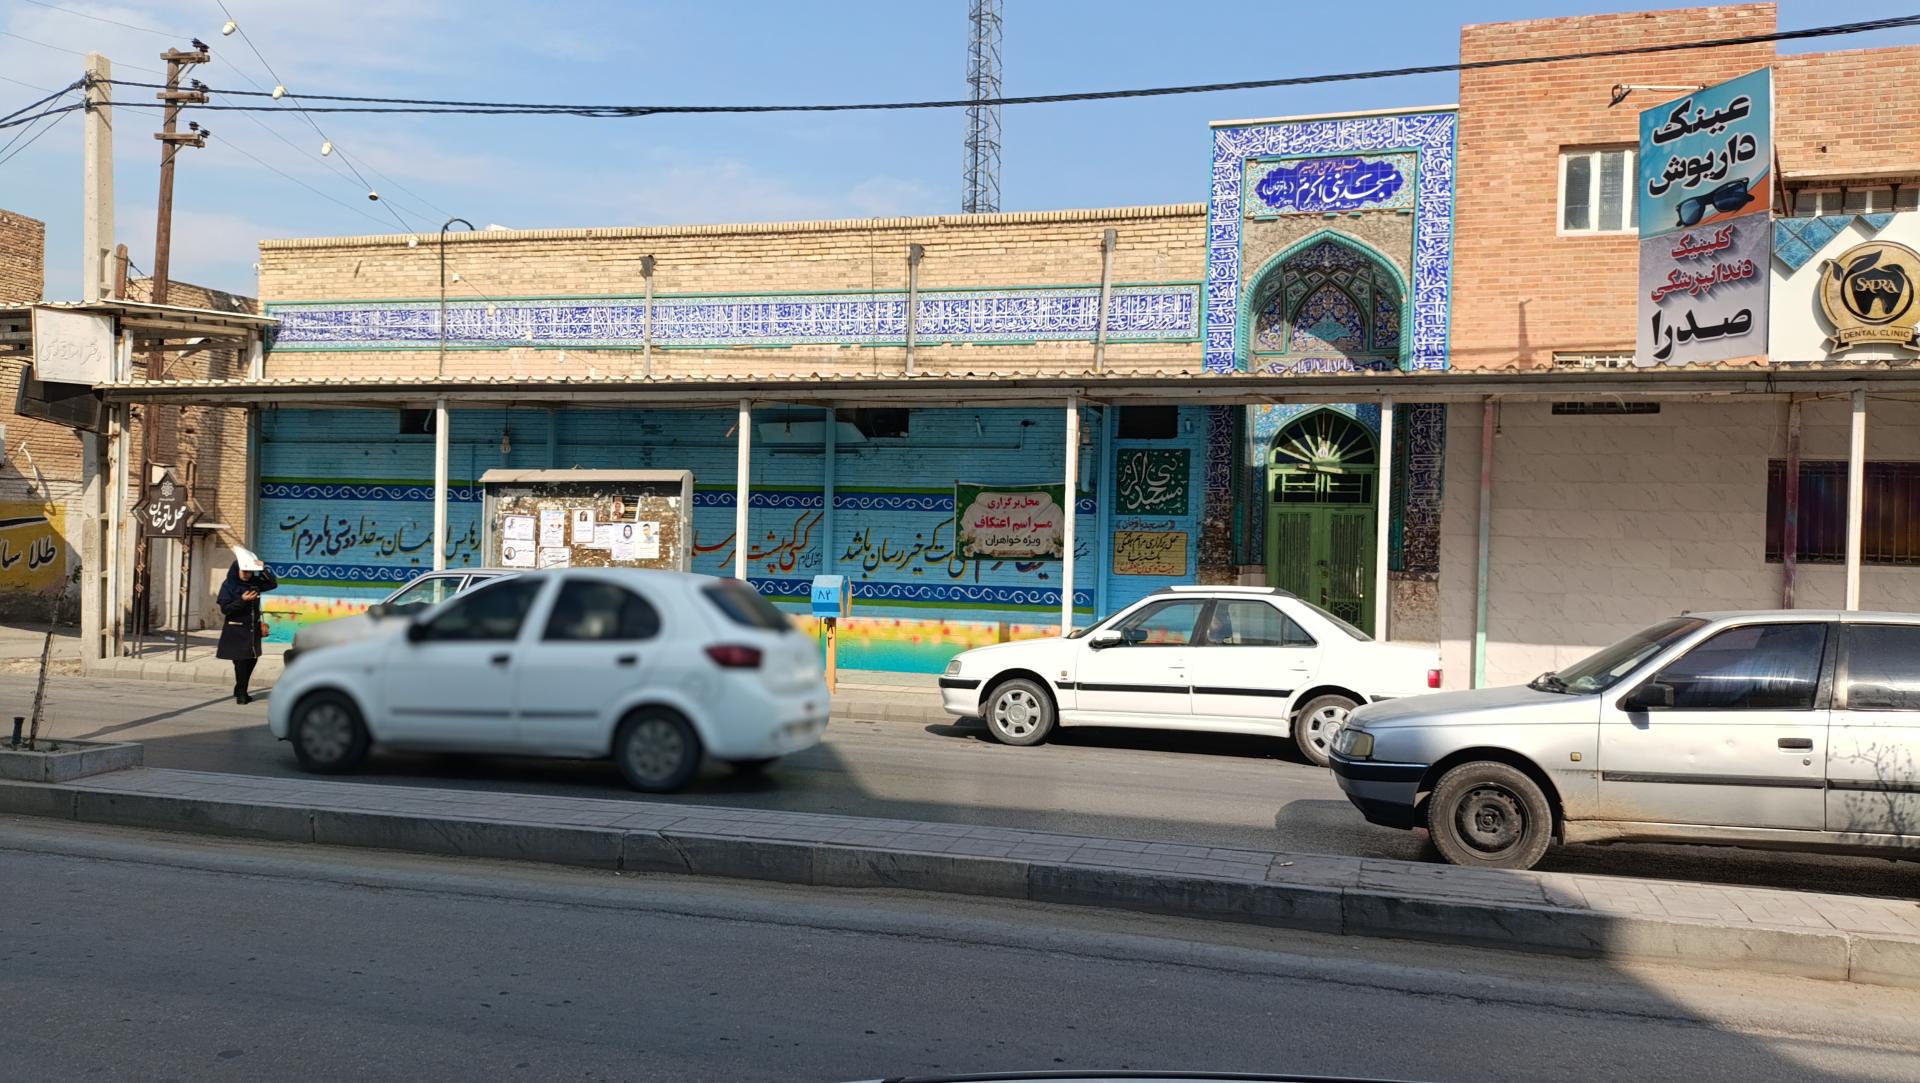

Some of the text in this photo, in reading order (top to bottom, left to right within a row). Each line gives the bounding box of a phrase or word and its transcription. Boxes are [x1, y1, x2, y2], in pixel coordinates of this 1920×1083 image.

[1653, 97, 1750, 143] عینک
[1650, 134, 1756, 194] داریوش
[1339, 173, 1396, 199] مسجد
[1671, 224, 1734, 259] کلینیک
[1651, 258, 1754, 302] دندانپزشکی
[1856, 278, 1900, 293] SADRA
[1652, 307, 1753, 359] صدرا
[1844, 329, 1910, 339] DENTAL CLINIC
[987, 496, 1040, 510] محل برگزاری
[1126, 485, 1183, 510] مسجد
[279, 513, 310, 549] است
[358, 515, 377, 545] خدا
[974, 515, 1053, 533] مراسم اعتکاف
[29, 535, 56, 569] طلا
[296, 528, 323, 560] مردم
[985, 534, 1041, 547] ویژه خواهران
